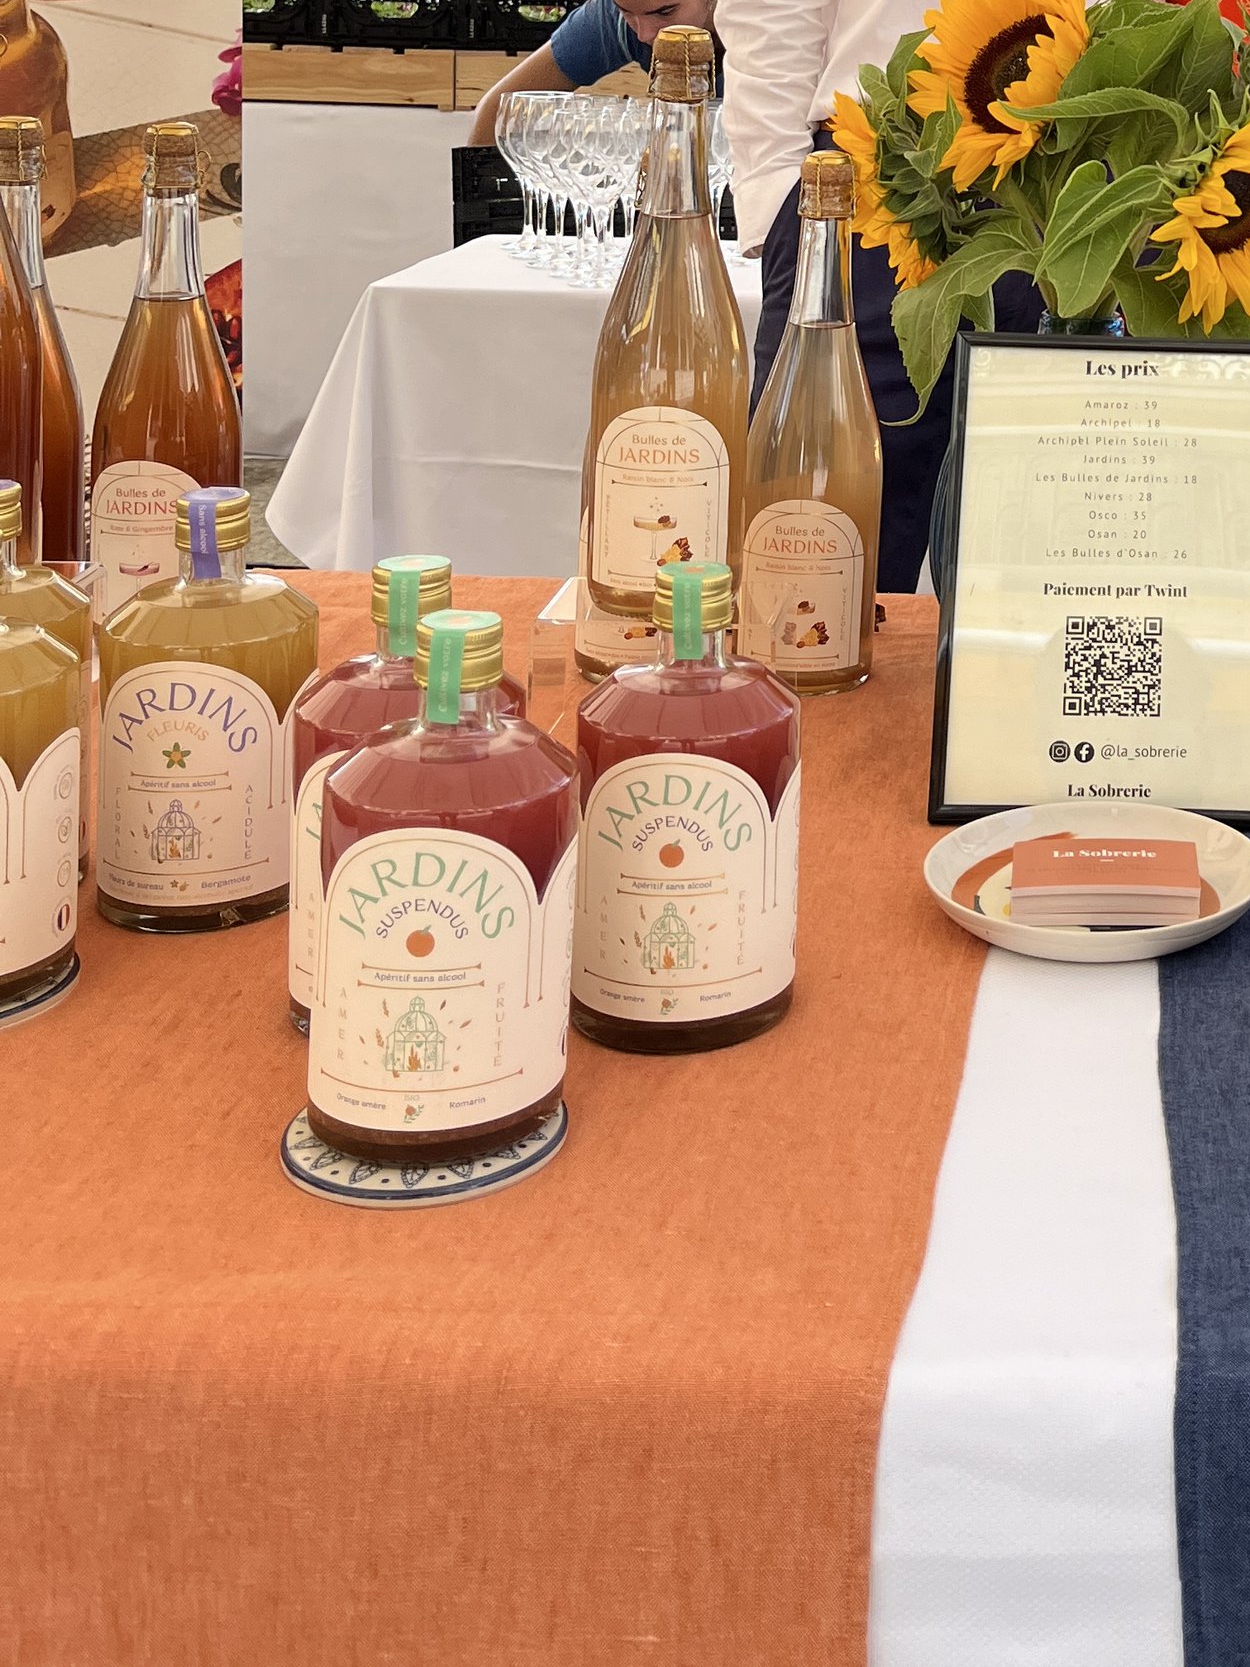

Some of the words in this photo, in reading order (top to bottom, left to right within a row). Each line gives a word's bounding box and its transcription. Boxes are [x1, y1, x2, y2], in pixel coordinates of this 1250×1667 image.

[1086, 360, 1117, 376] Les
[1121, 360, 1159, 379] prix
[1084, 400, 1129, 410] Amaroz
[1143, 400, 1158, 410] 39
[1080, 419, 1132, 429] Archipel
[1147, 419, 1161, 428] 18
[632, 434, 668, 446] Bulles
[672, 435, 687, 446] de
[1095, 437, 1127, 446] Plein
[1132, 437, 1169, 447] Soleil
[1183, 438, 1198, 448] 28
[618, 446, 700, 465] JARDINS
[1082, 455, 1127, 464] Jardins
[1142, 455, 1156, 465] 39
[1035, 472, 1056, 482] Les
[1061, 473, 1100, 483] Bulles
[1105, 473, 1120, 483] de
[1124, 474, 1169, 484] Jardins
[1183, 475, 1198, 484] 18
[116, 488, 149, 498] Bulles
[151, 488, 166, 498] de
[1084, 491, 1124, 501] Nivers
[1138, 492, 1153, 502] 28
[106, 498, 178, 515] JARDINS
[198, 504, 207, 526] Sans
[1088, 510, 1118, 520] Osco
[1132, 510, 1147, 520] 35
[132, 525, 174, 533] Gingembre
[775, 525, 808, 537] Bulles
[811, 526, 825, 537] de
[1087, 529, 1118, 539] Osan
[1132, 529, 1147, 539] 20
[199, 528, 209, 554] alcool
[763, 536, 837, 555] JARDINS
[1045, 547, 1066, 557] Les
[1072, 548, 1111, 558] Bulles
[1173, 549, 1188, 559] 26
[1043, 582, 1112, 597] Paiement
[1115, 584, 1142, 599] par
[1144, 583, 1188, 598] Twint
[111, 681, 258, 754] JARDINS
[146, 720, 210, 743] FLEURIS
[1100, 744, 1188, 761] @la_sobrerie
[140, 780, 170, 789] Apéritif
[171, 781, 190, 789] sans
[192, 779, 217, 788] alcool
[1067, 784, 1086, 798] La
[1088, 783, 1152, 798] Sobrerie
[597, 774, 752, 852] JARDINS
[114, 786, 122, 860] FLORAL
[631, 815, 714, 853] SUSPENDUS
[1052, 848, 1075, 859] La
[1078, 848, 1158, 859] Sobrerie
[137, 881, 164, 891] sureau
[200, 874, 252, 889] Bergamote
[631, 880, 663, 891] Apéritif
[665, 883, 685, 891] sans
[687, 880, 712, 890] alcool
[338, 851, 515, 939] JARDINS
[375, 897, 470, 940] SUSPENDUS
[374, 972, 411, 983] Apéritif
[413, 975, 435, 983] sans
[437, 971, 467, 982] alcool
[700, 991, 732, 1003] Romarin
[336, 986, 348, 1061] AMER
[336, 1092, 360, 1107] Orange
[361, 1099, 387, 1110] amère
[449, 1096, 486, 1110] Romarin
